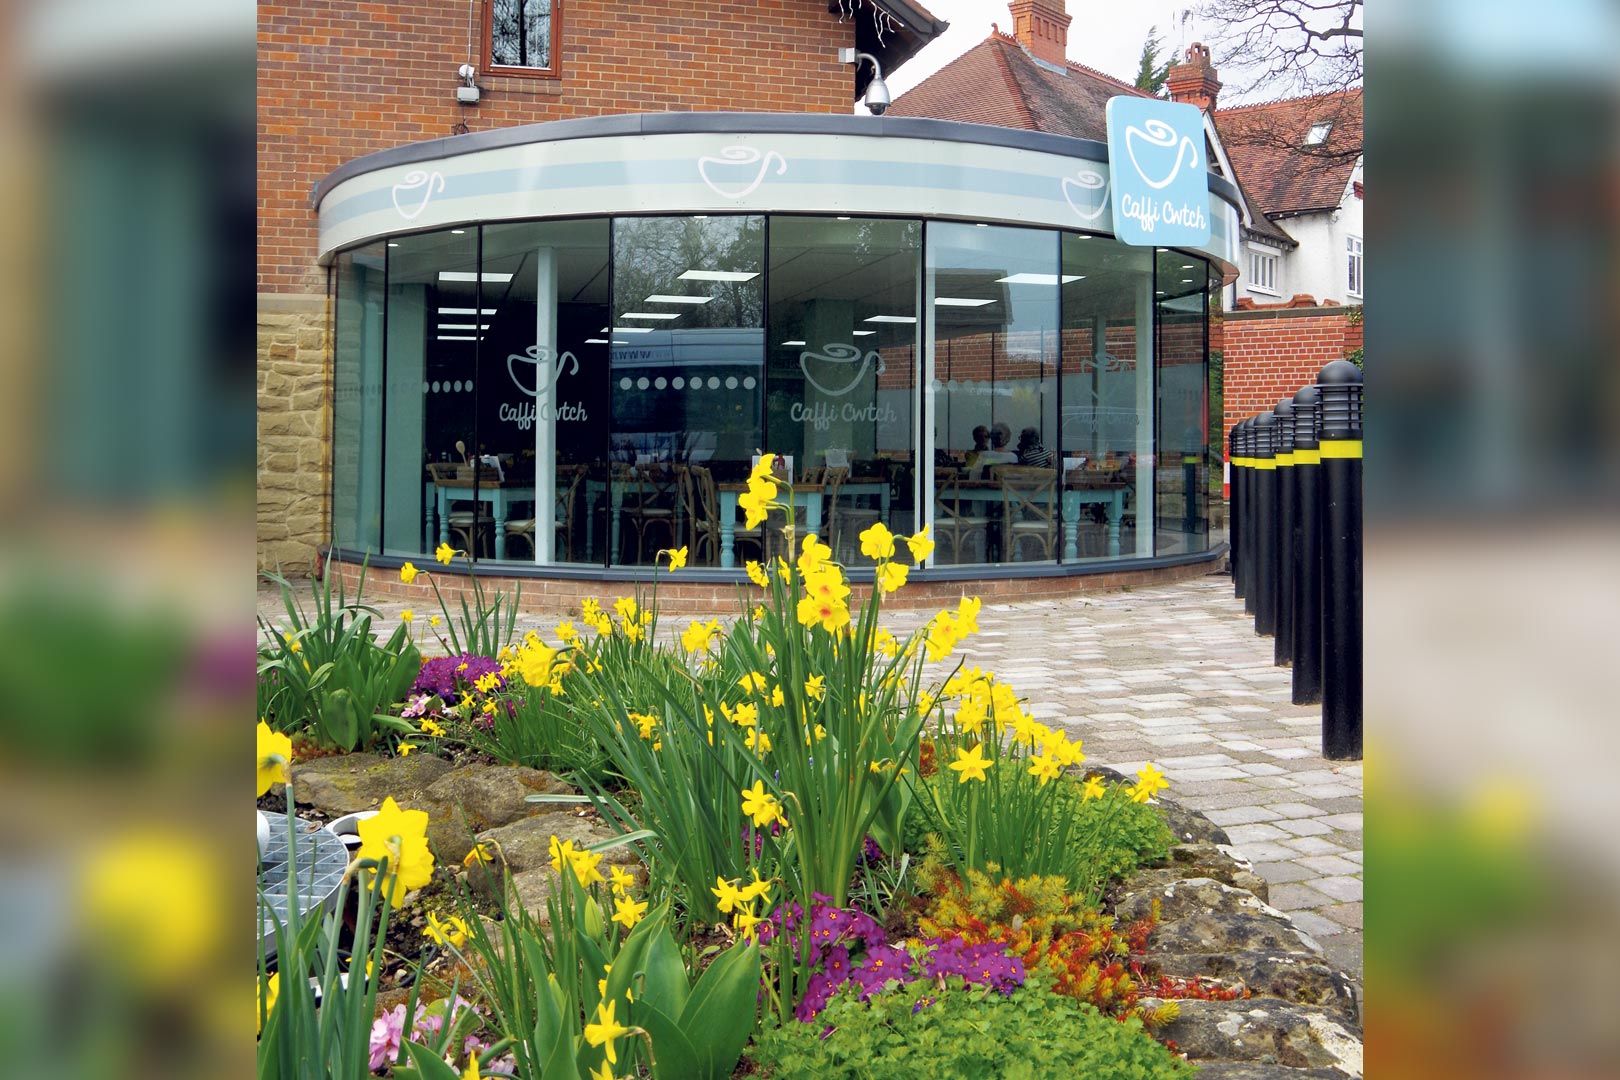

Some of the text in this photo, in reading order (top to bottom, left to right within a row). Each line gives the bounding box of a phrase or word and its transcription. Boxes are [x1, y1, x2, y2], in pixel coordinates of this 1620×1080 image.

[1121, 193, 1206, 232] Caffi Cwtch
[499, 402, 537, 430] Caffi
[790, 401, 897, 430] Caffi Cwtch
